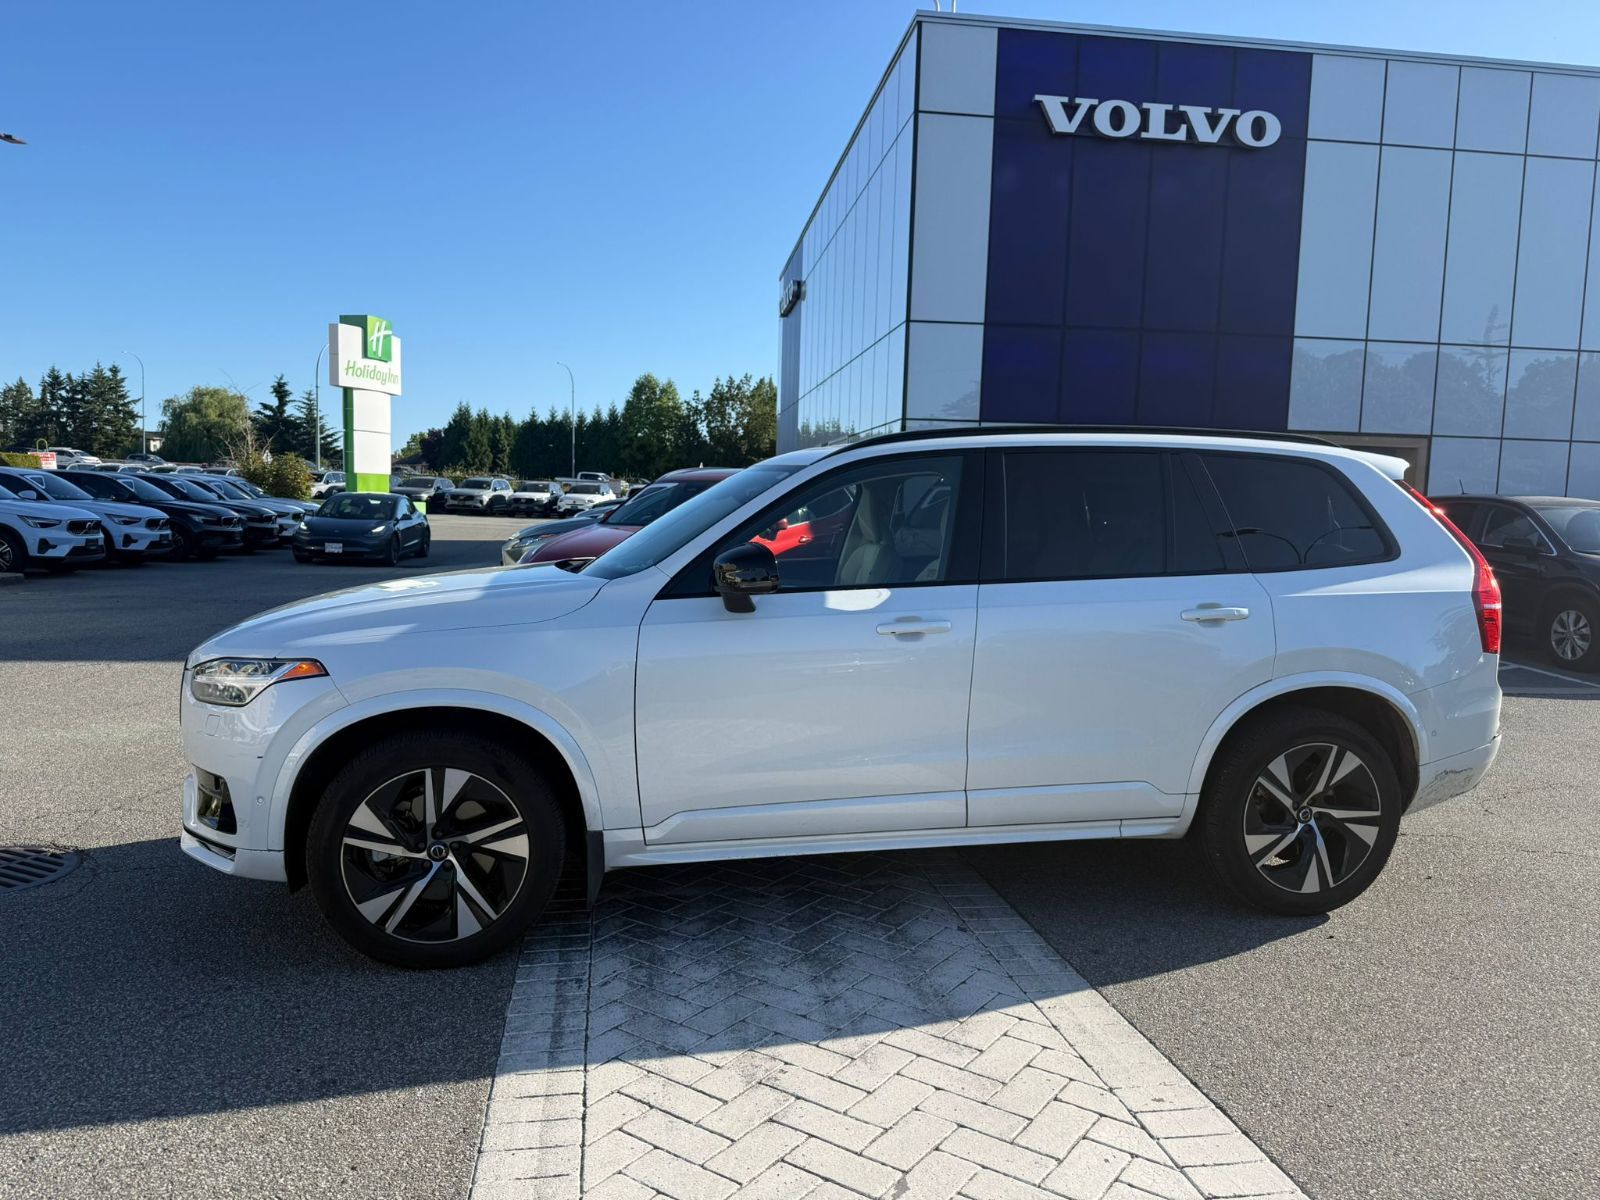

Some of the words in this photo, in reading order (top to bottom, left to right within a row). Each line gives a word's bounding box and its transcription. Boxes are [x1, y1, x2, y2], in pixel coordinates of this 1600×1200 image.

[1033, 94, 1282, 148] VOLVO
[345, 360, 387, 386] Holiday
[388, 367, 399, 385] Inn
